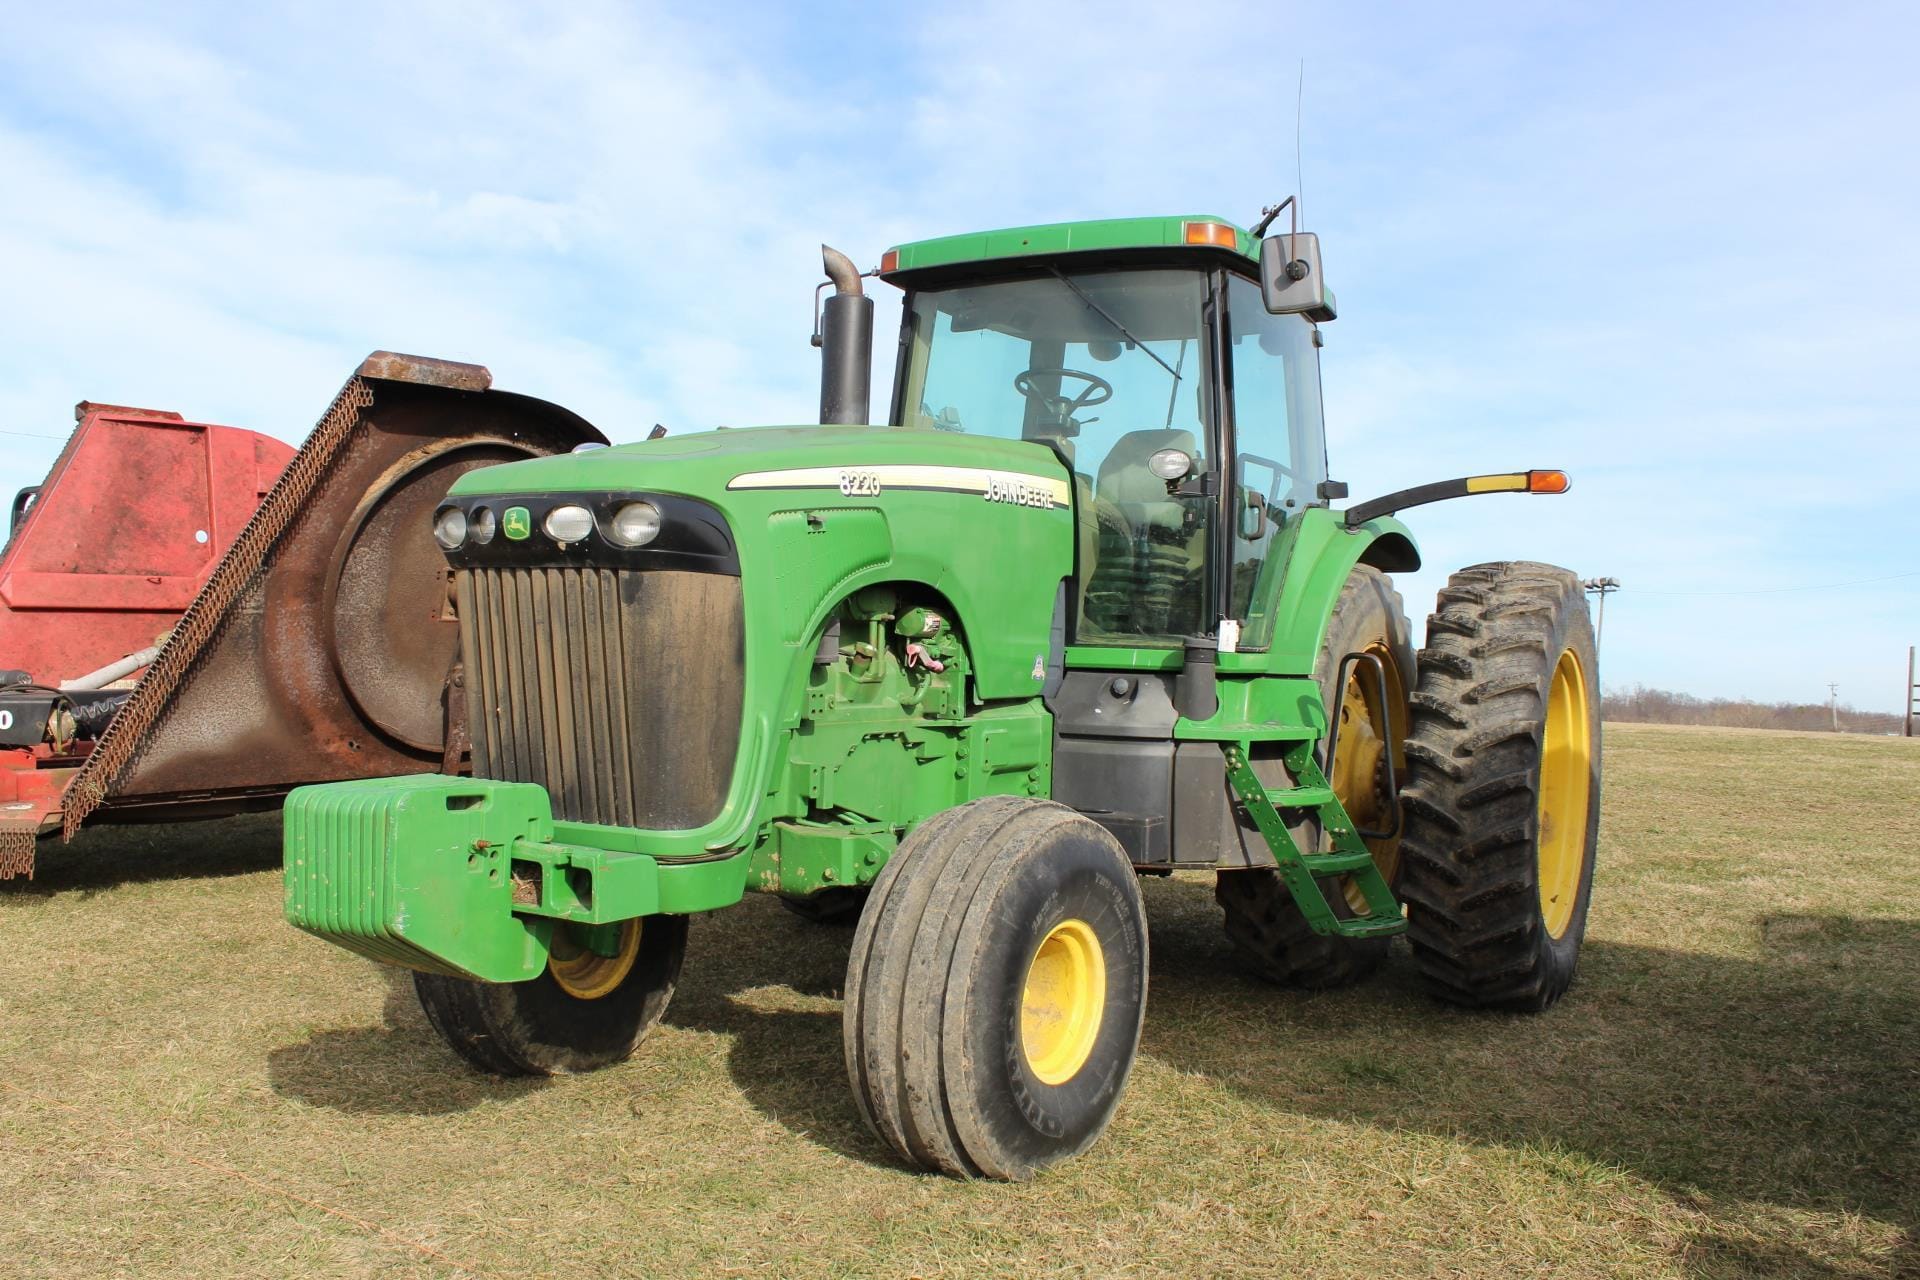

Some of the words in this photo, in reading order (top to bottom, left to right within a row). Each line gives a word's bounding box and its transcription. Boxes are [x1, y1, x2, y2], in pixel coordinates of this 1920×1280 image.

[839, 470, 881, 497] 8220
[983, 474, 1019, 504] JOHN
[1018, 480, 1054, 510] DEERE
